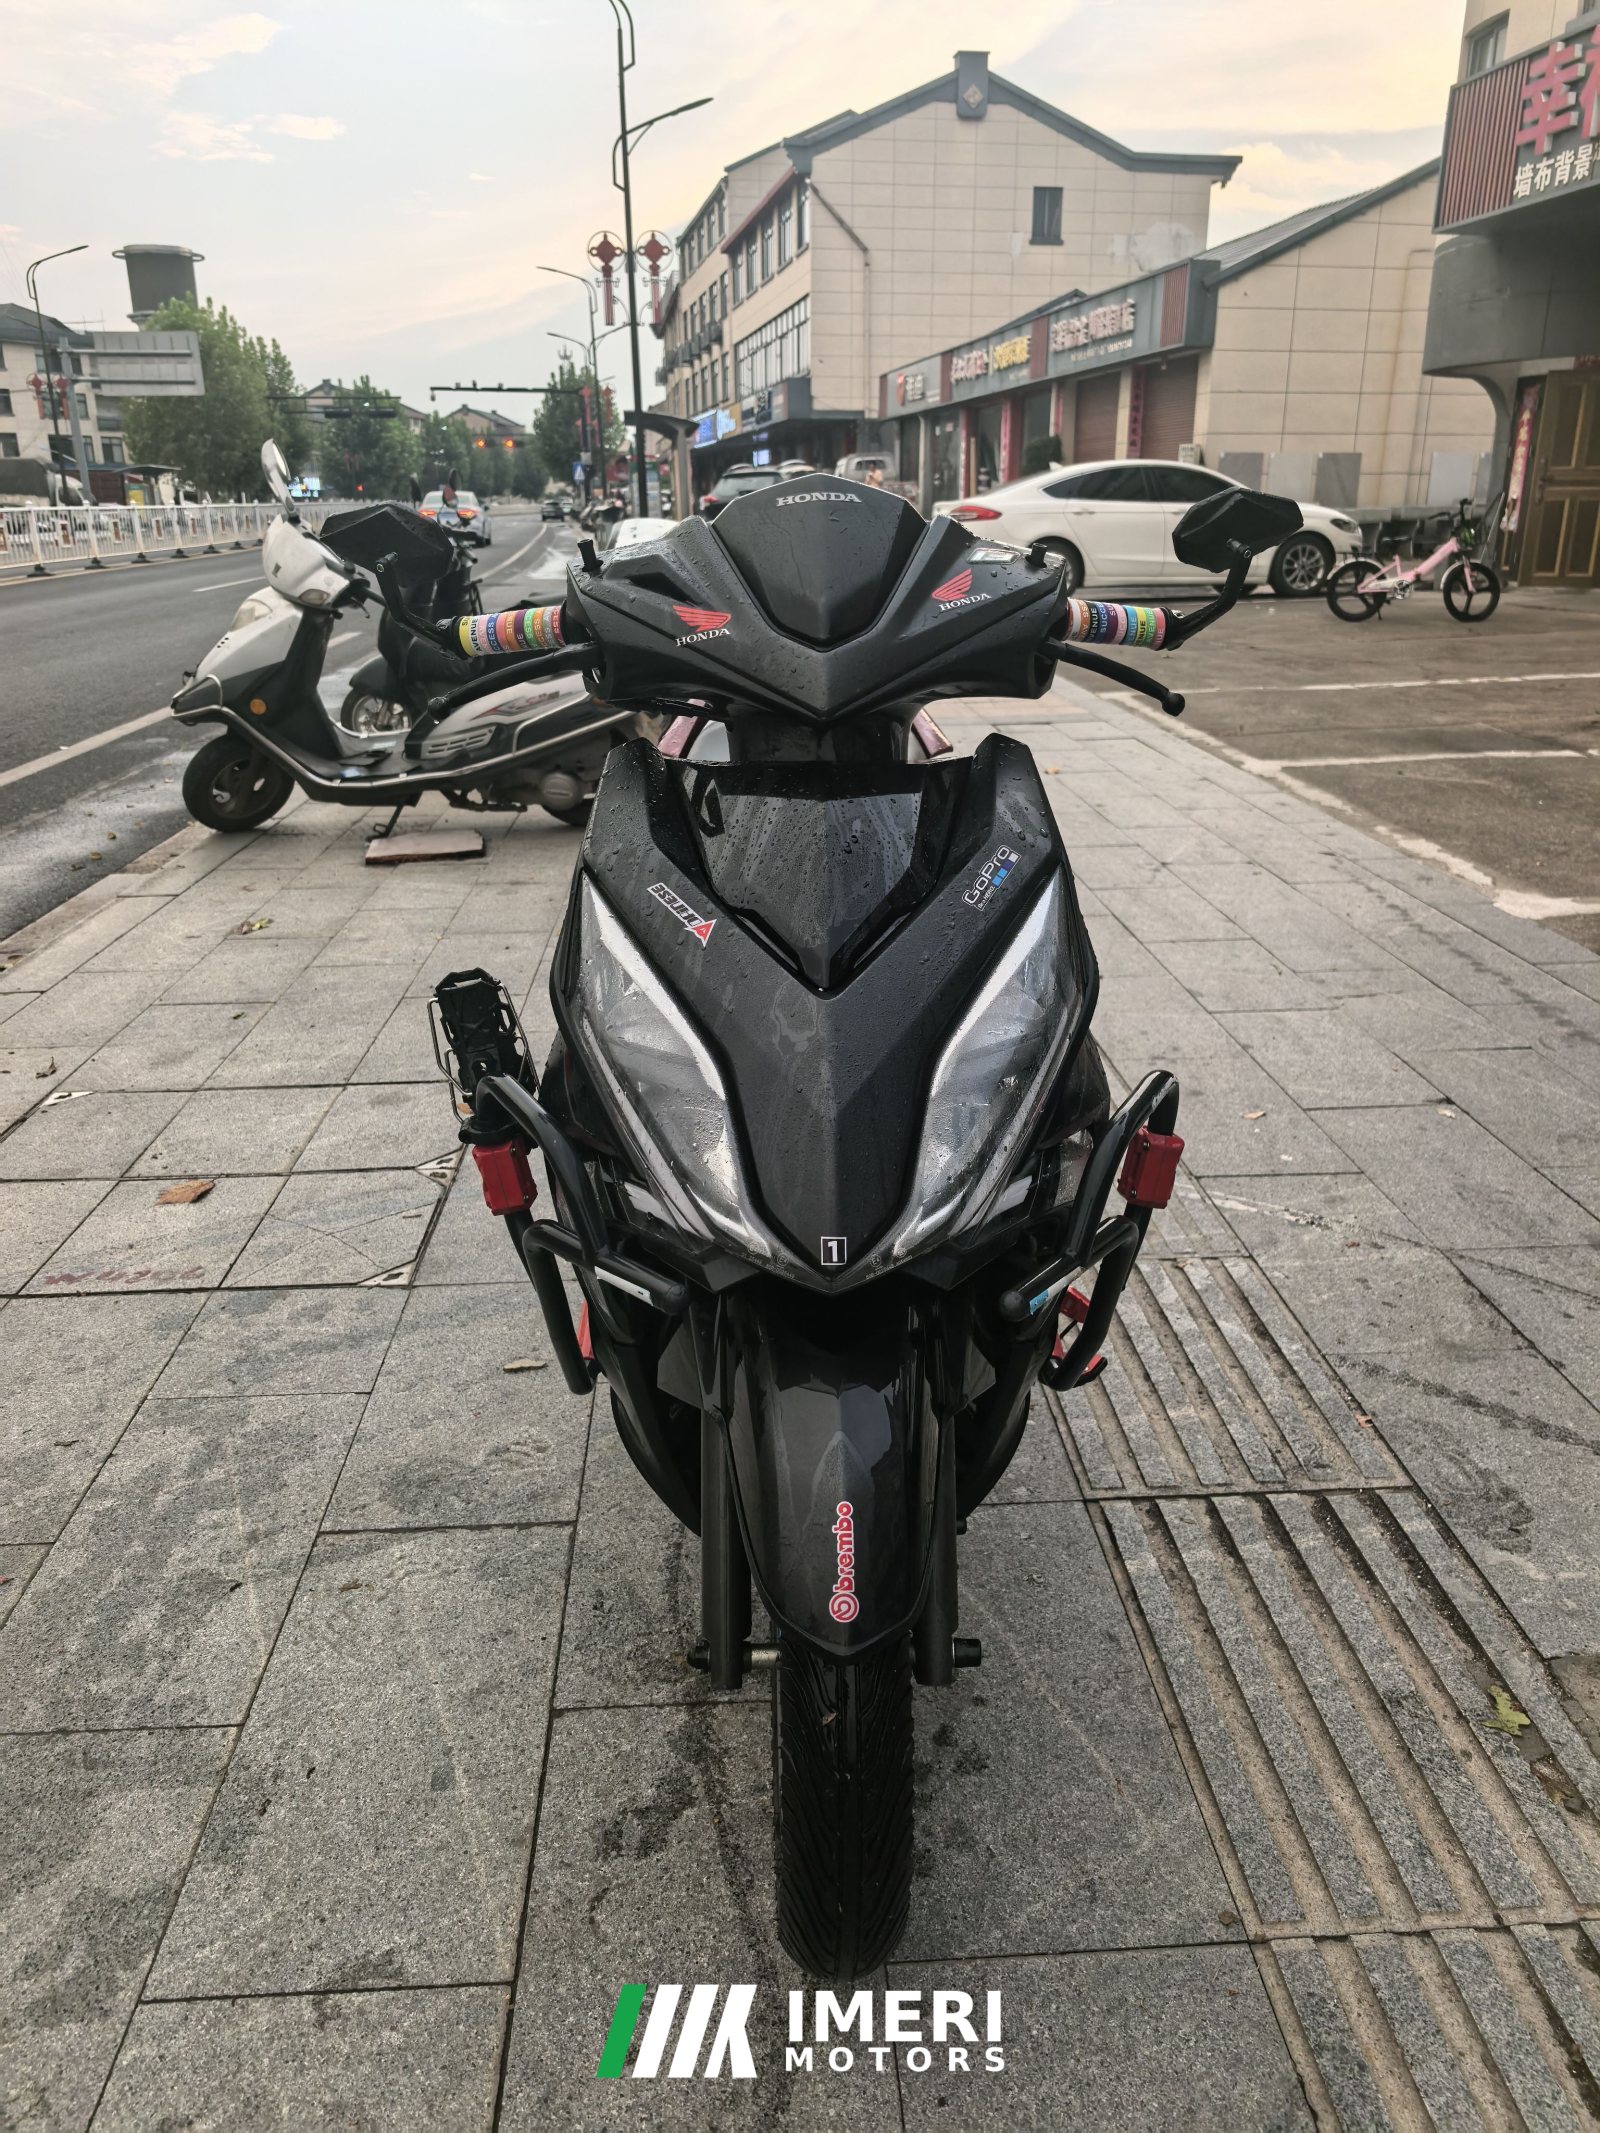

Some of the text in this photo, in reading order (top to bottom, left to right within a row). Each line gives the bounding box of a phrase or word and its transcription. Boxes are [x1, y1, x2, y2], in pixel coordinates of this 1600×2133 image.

[1513, 143, 1600, 198] 墙布背景
[776, 492, 862, 507] HONDA
[938, 592, 992, 612] HONDA
[470, 618, 482, 652] AVENUE
[675, 627, 732, 647] HONDA
[964, 846, 1010, 904] GoPro
[827, 1240, 839, 1263] 1
[832, 1501, 854, 1593] brembo
